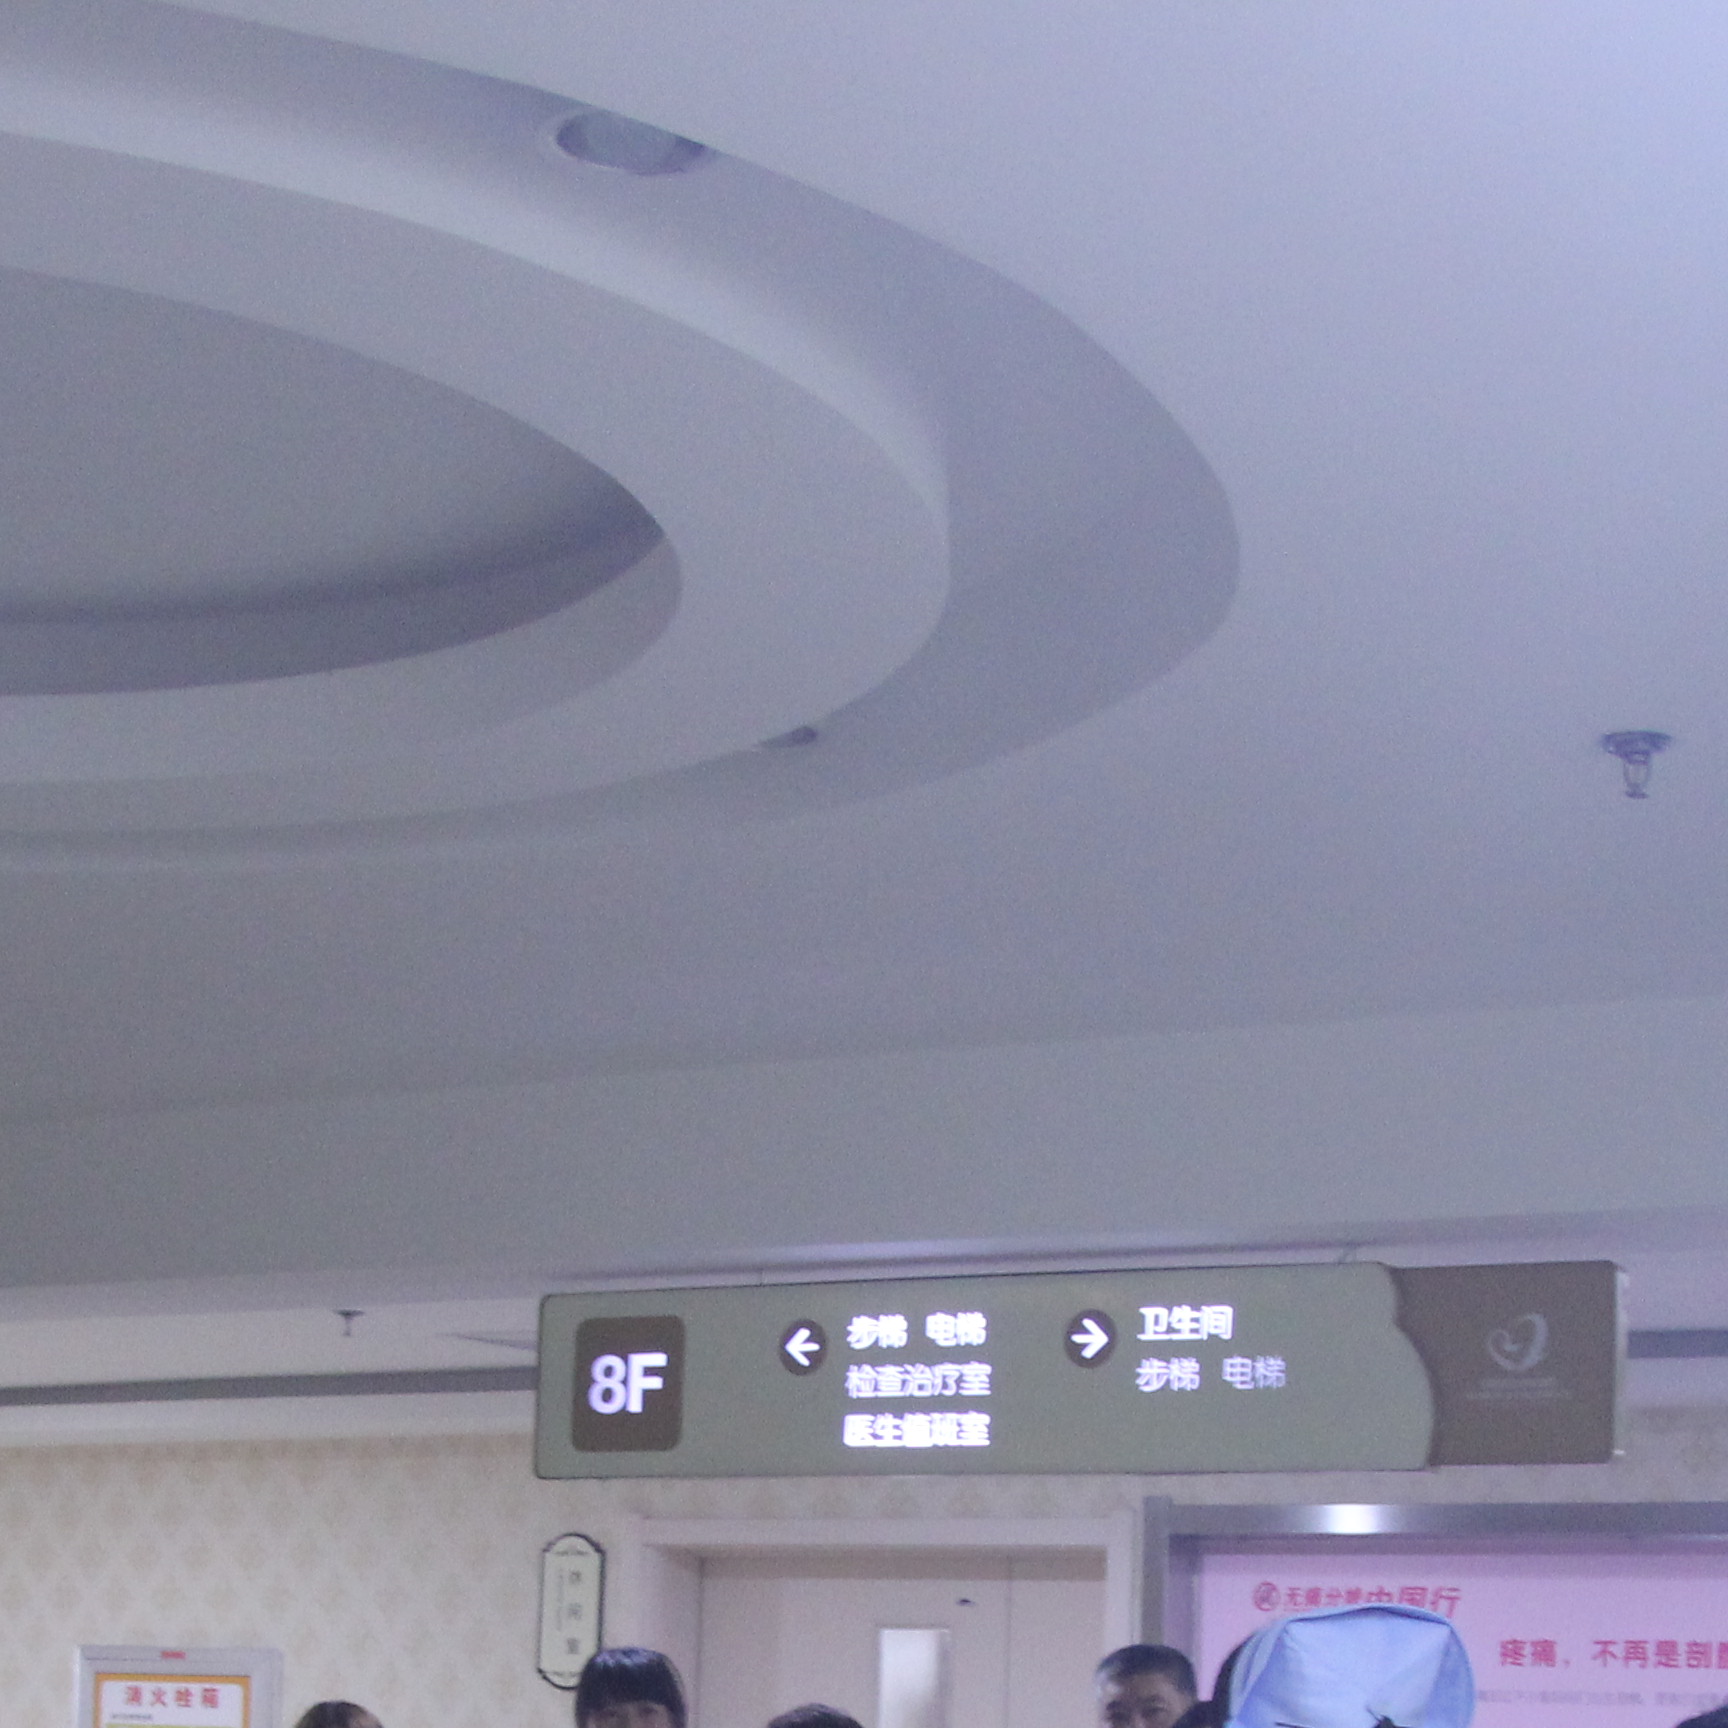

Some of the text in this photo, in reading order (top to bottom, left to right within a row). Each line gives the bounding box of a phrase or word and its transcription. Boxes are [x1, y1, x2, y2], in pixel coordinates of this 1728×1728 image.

[845, 1311, 987, 1350] 步梯 电梯
[1136, 1304, 1234, 1341] 卫生间
[587, 1351, 669, 1415] 8F
[844, 1361, 993, 1399] 检查治疗室
[1136, 1354, 1287, 1392] 步梯 电梯
[842, 1411, 992, 1448] 医生值班室
